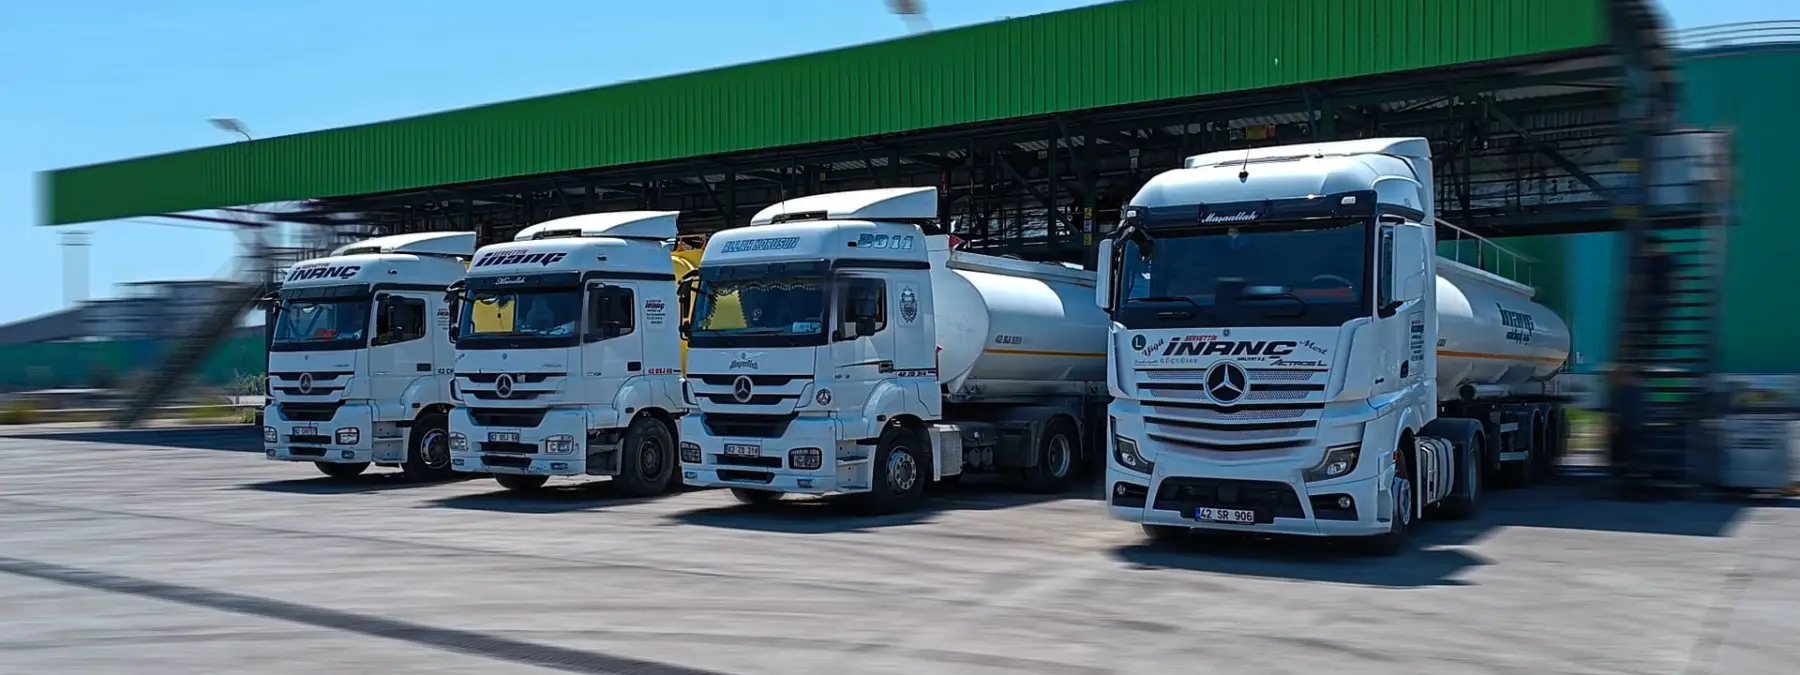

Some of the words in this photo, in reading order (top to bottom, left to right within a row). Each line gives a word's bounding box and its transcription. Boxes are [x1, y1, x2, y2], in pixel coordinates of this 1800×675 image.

[857, 233, 914, 250] 2011
[1200, 508, 1212, 519] 42
[1217, 509, 1229, 520] SR
[1234, 511, 1253, 522] 906
